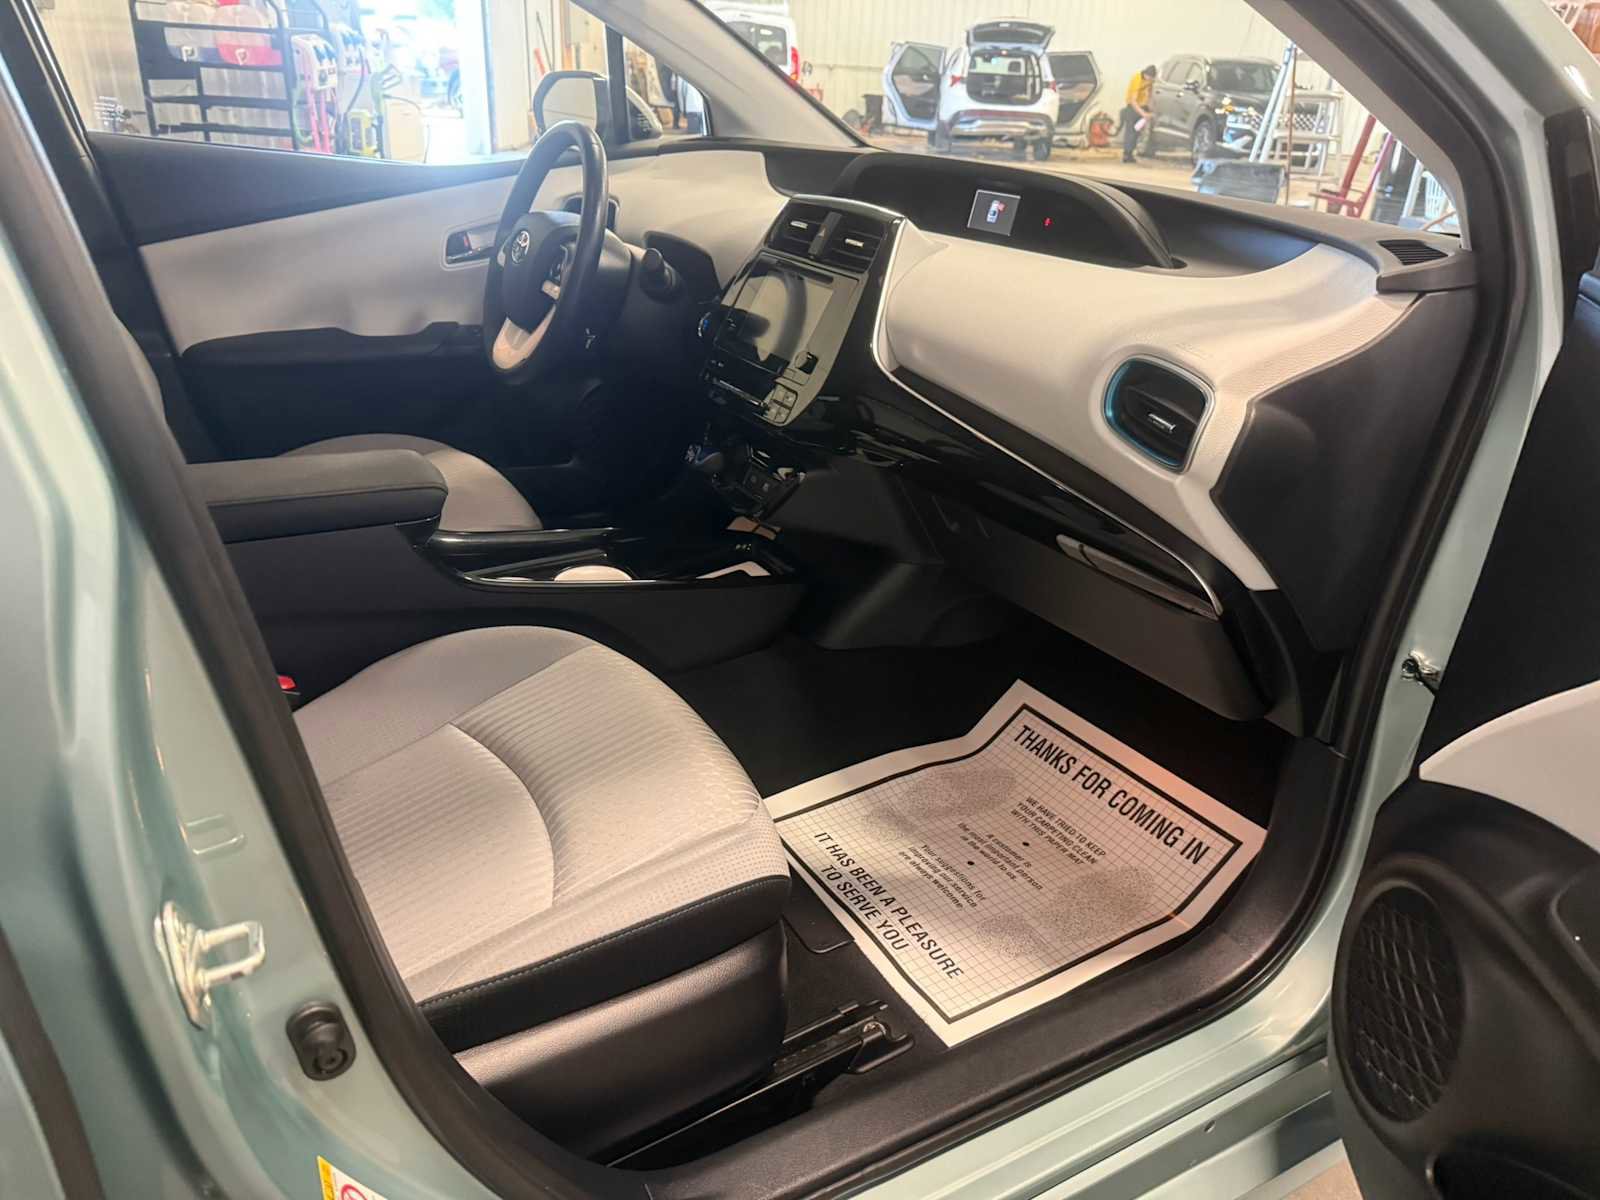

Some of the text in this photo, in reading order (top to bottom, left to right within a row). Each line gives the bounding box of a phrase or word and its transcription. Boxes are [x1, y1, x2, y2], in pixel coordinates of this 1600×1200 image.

[1014, 725, 1210, 864] THANKS FOR COMING IN
[992, 838, 1024, 860] customer
[1011, 809, 1084, 864] WITH THIS PAPER MAT
[1017, 802, 1097, 864] YOUR CARPETING CLEAN
[1026, 796, 1106, 856] WE HAVE TRIED TO KEEP
[899, 852, 911, 860] are
[910, 861, 933, 880] always
[908, 847, 941, 874] improving
[940, 873, 953, 882] our
[922, 844, 986, 900] Your suggestions for
[958, 823, 970, 831] the
[984, 844, 1020, 868] important
[1016, 869, 1043, 890] person
[980, 850, 1000, 864] world
[814, 832, 964, 979] IT HAS BEEN A PLEASURE
[821, 865, 909, 950] TO SERVE YOU
